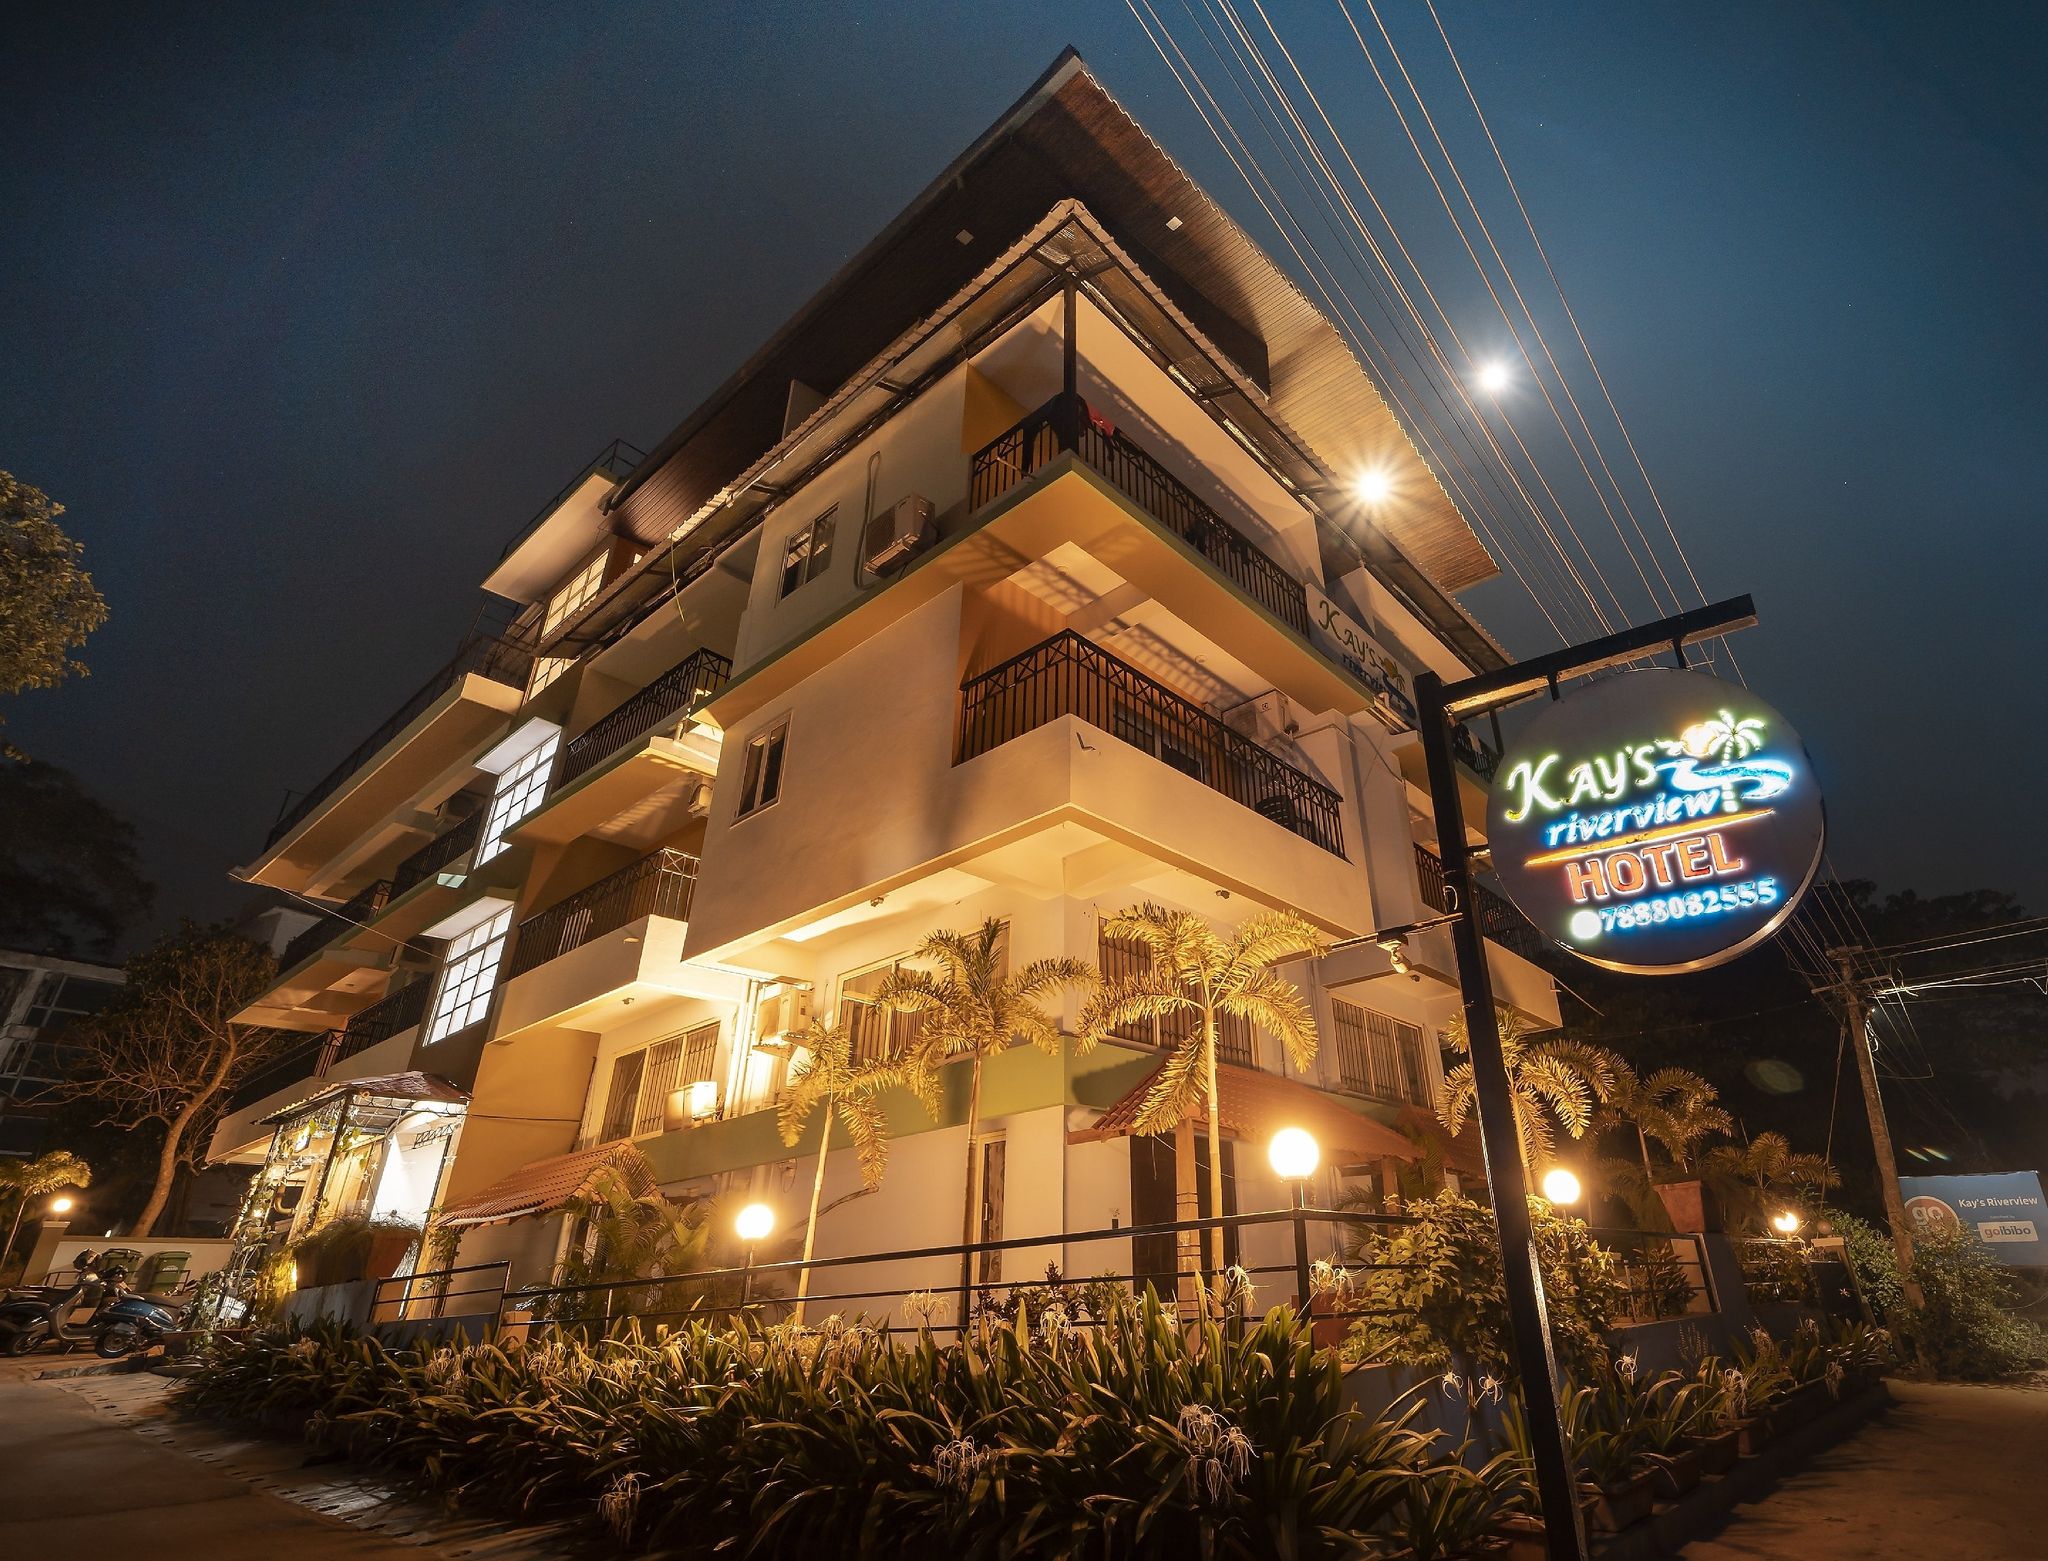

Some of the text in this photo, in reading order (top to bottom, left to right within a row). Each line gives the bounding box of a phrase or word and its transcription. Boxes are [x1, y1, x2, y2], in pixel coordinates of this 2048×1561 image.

[1547, 789, 1720, 846] riverview
[1566, 833, 1743, 902] HOTEL
[1958, 1197, 2038, 1209] Kay's Riverview
[1984, 1225, 2031, 1238] goibibo
